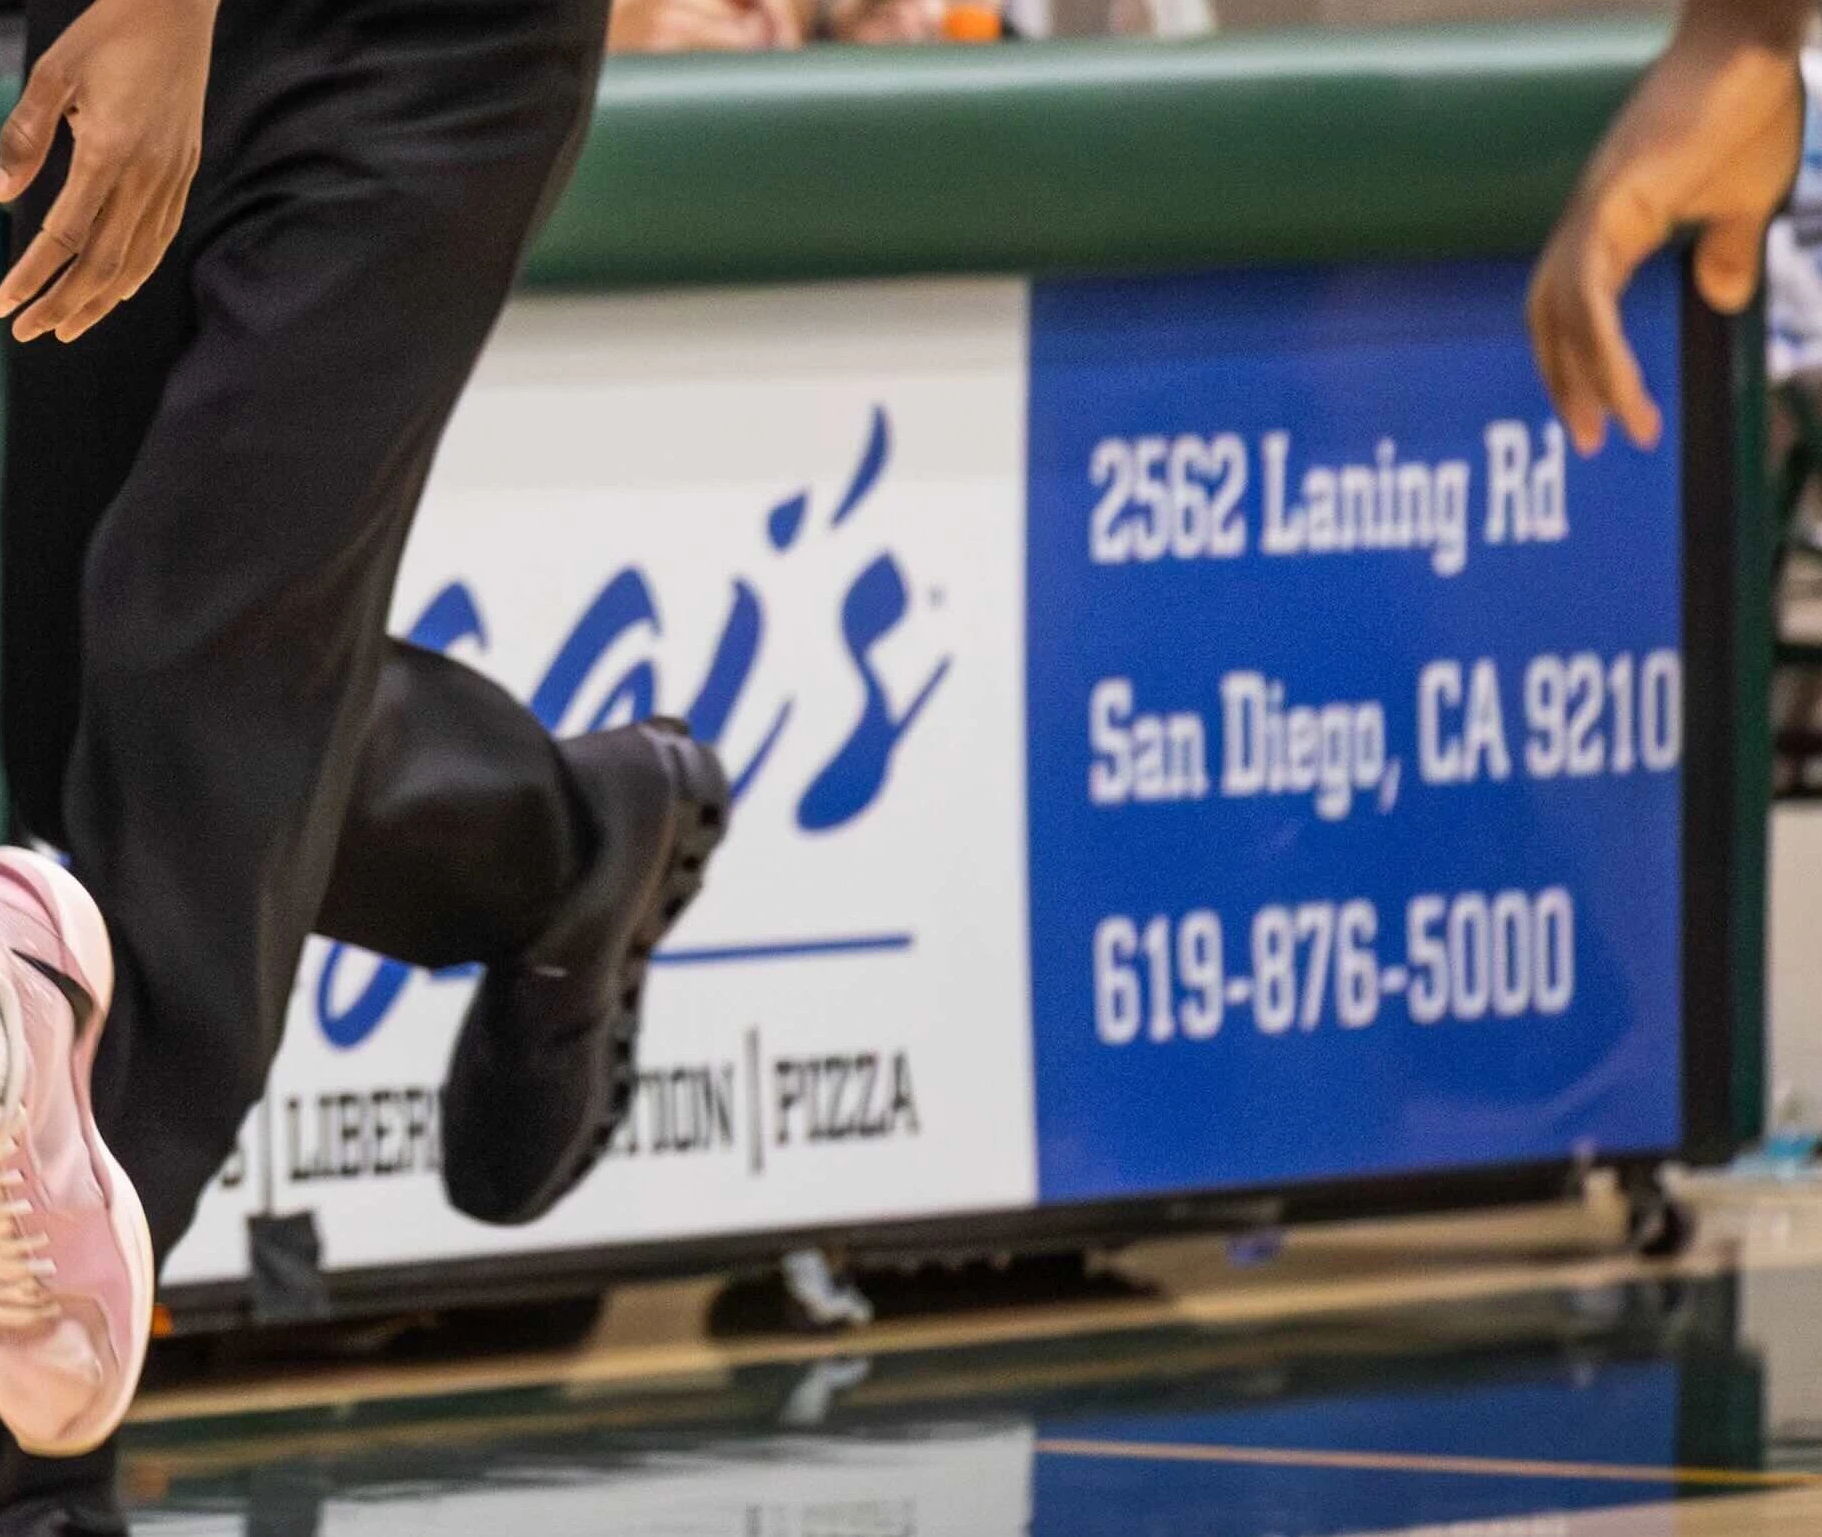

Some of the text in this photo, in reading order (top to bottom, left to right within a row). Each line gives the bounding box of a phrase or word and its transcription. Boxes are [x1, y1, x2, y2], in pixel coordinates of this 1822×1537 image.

[1088, 420, 1570, 577] 2562 Laning Rd
[1089, 648, 1683, 821] San Diego, CA 9210
[1092, 887, 1575, 1046] 619-876-5000
[609, 1063, 735, 1154] TION
[775, 1051, 920, 1147] PIZZA
